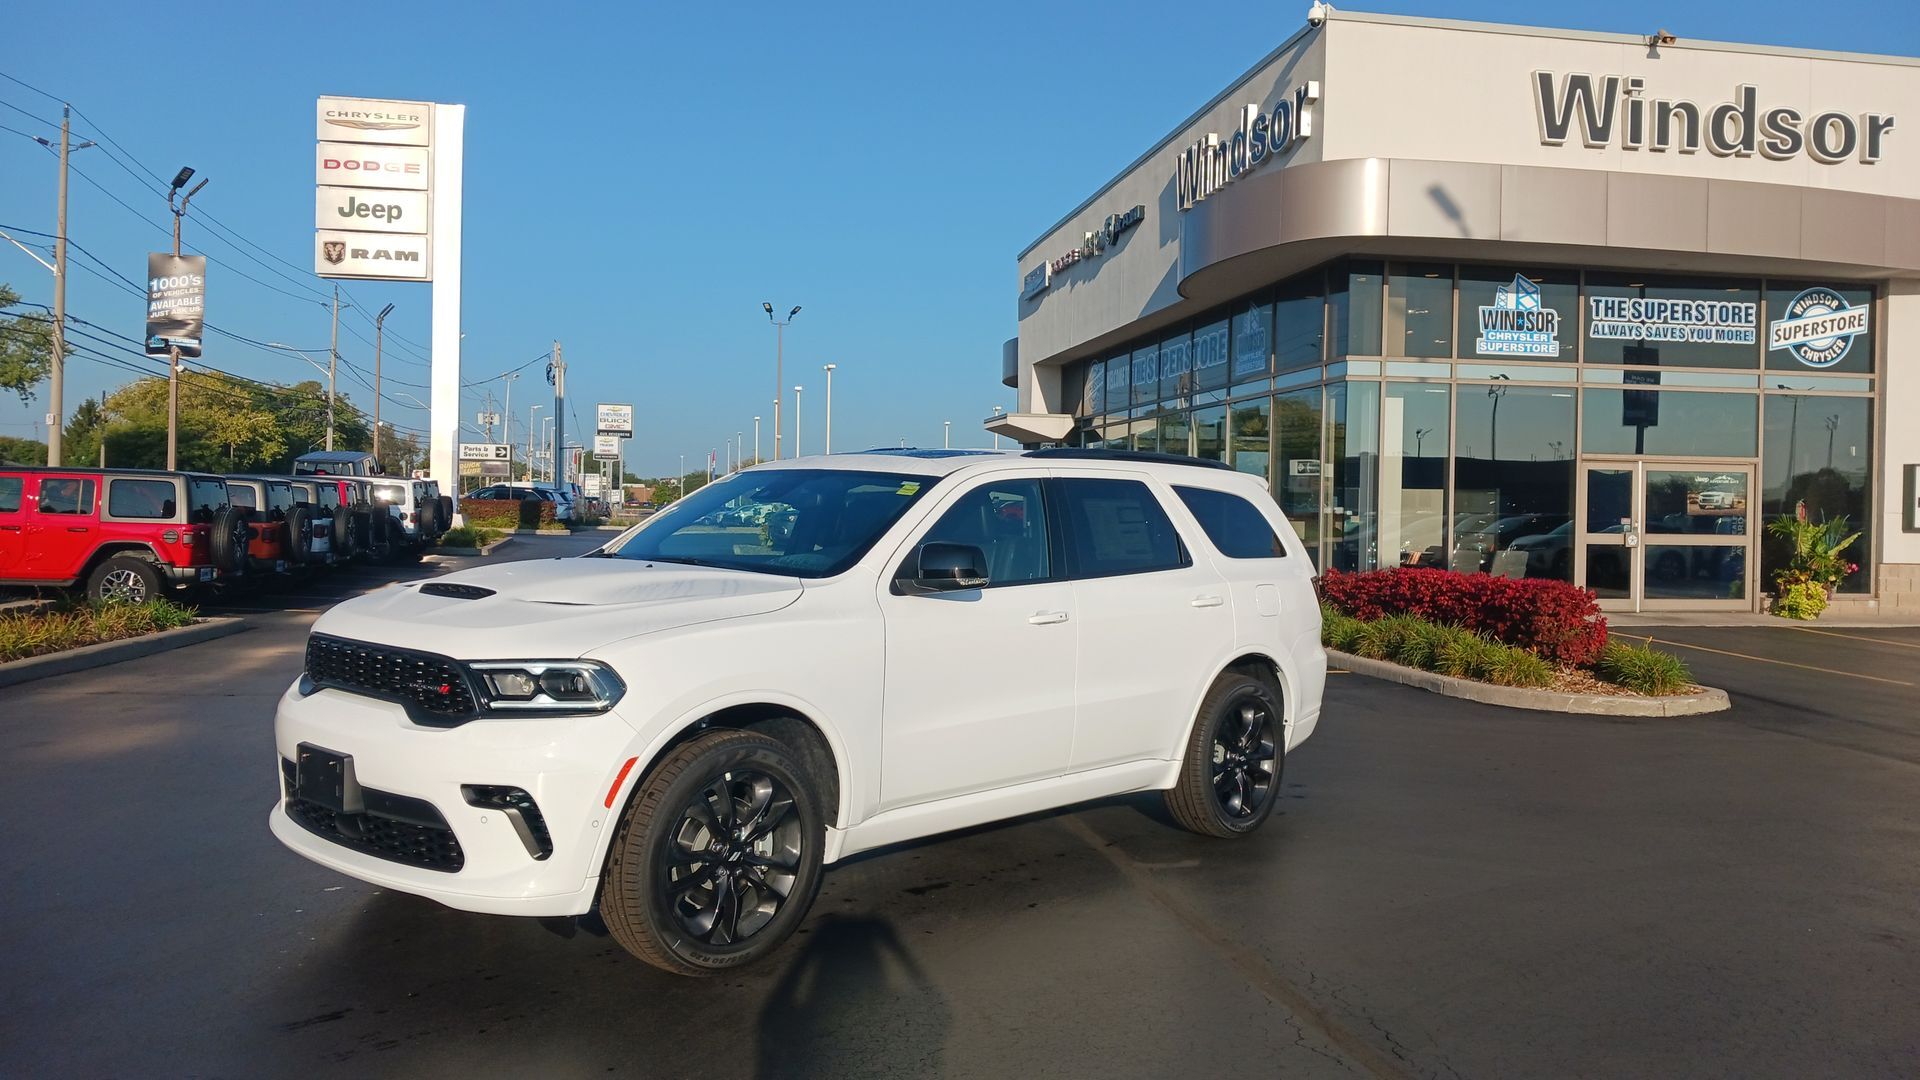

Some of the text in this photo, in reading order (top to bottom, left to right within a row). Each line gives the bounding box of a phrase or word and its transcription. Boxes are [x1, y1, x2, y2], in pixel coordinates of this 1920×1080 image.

[326, 110, 420, 122] CHRYSLER
[1530, 69, 1896, 165] Windsor
[1175, 80, 1319, 212] Windsor
[323, 158, 421, 174] DODGE
[338, 196, 403, 224] Jeep
[351, 248, 419, 262] RAM
[150, 274, 201, 291] 1000's
[152, 287, 200, 299] OF VEHICLES
[150, 296, 200, 312] AVAILABLE
[1593, 298, 1754, 324] THE SUPERSTORE
[1793, 293, 1839, 315] WINDSOR
[150, 309, 170, 318] JUST
[1482, 309, 1555, 332] WINDSOR
[1488, 332, 1548, 342] CHRYSLER
[1592, 323, 1754, 342] ALWAYS SAVES YOU MORE!
[1774, 313, 1865, 343] SUPERSTORE
[1480, 342, 1556, 353] SUPERSTORE
[1800, 339, 1846, 363] CHRYSLER
